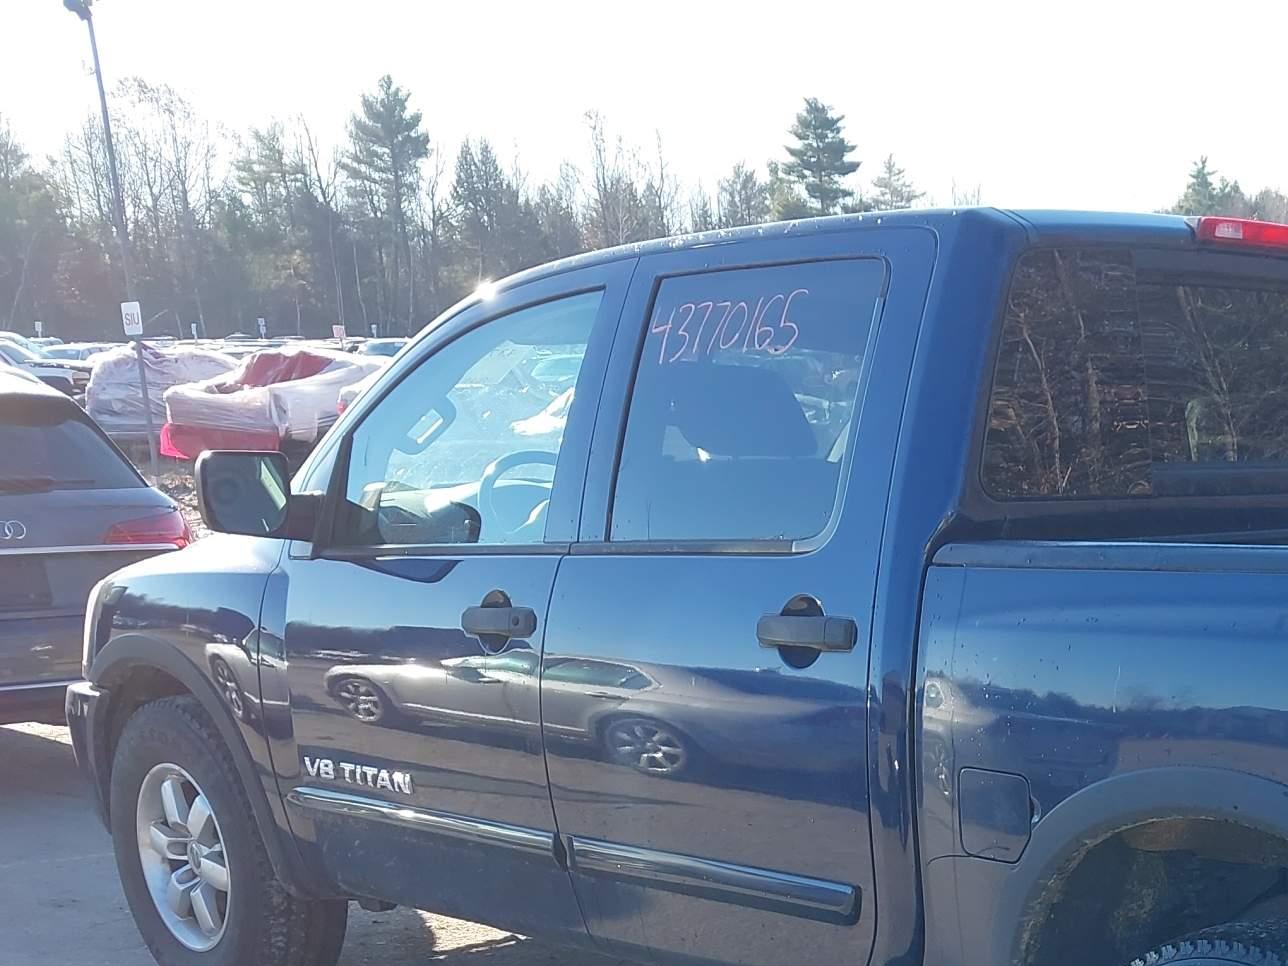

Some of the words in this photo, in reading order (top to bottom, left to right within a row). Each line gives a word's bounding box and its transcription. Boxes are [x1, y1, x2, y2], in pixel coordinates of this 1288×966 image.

[651, 288, 809, 365] 43770165
[303, 756, 335, 780] V8
[339, 761, 412, 796] TITAN
